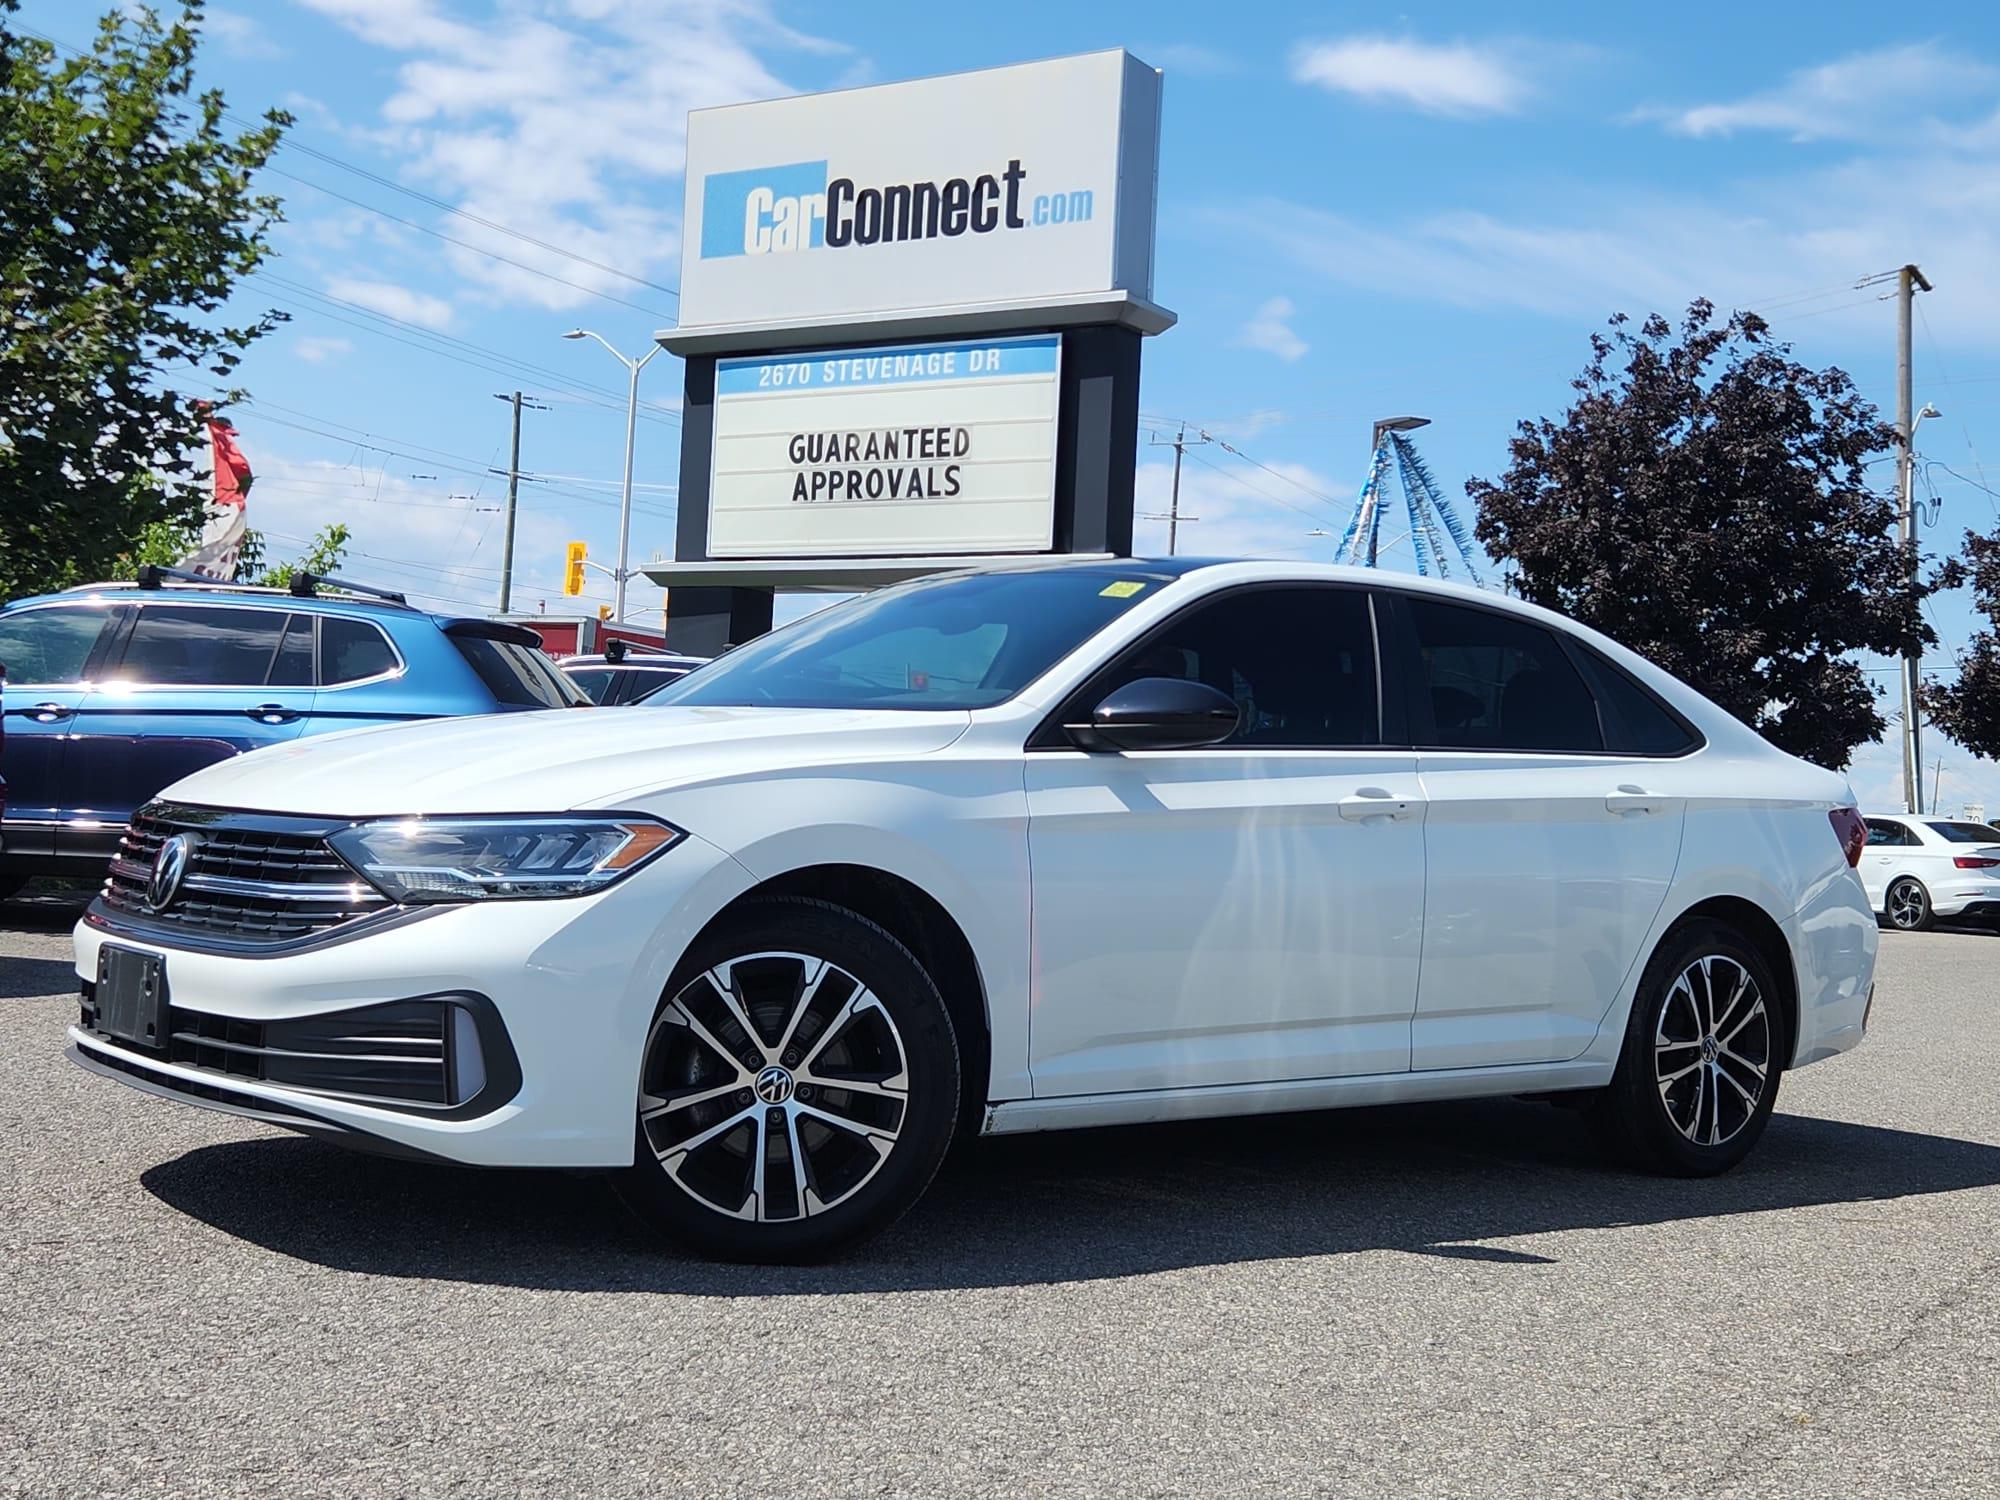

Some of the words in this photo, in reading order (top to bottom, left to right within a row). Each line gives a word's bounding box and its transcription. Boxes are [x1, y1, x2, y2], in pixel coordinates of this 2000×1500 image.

[759, 362, 811, 387] 2670
[823, 351, 955, 383] STEVENAGE
[969, 348, 1001, 372] DR
[788, 426, 970, 464] GUARANTEED
[792, 465, 961, 501] APPROVALS
